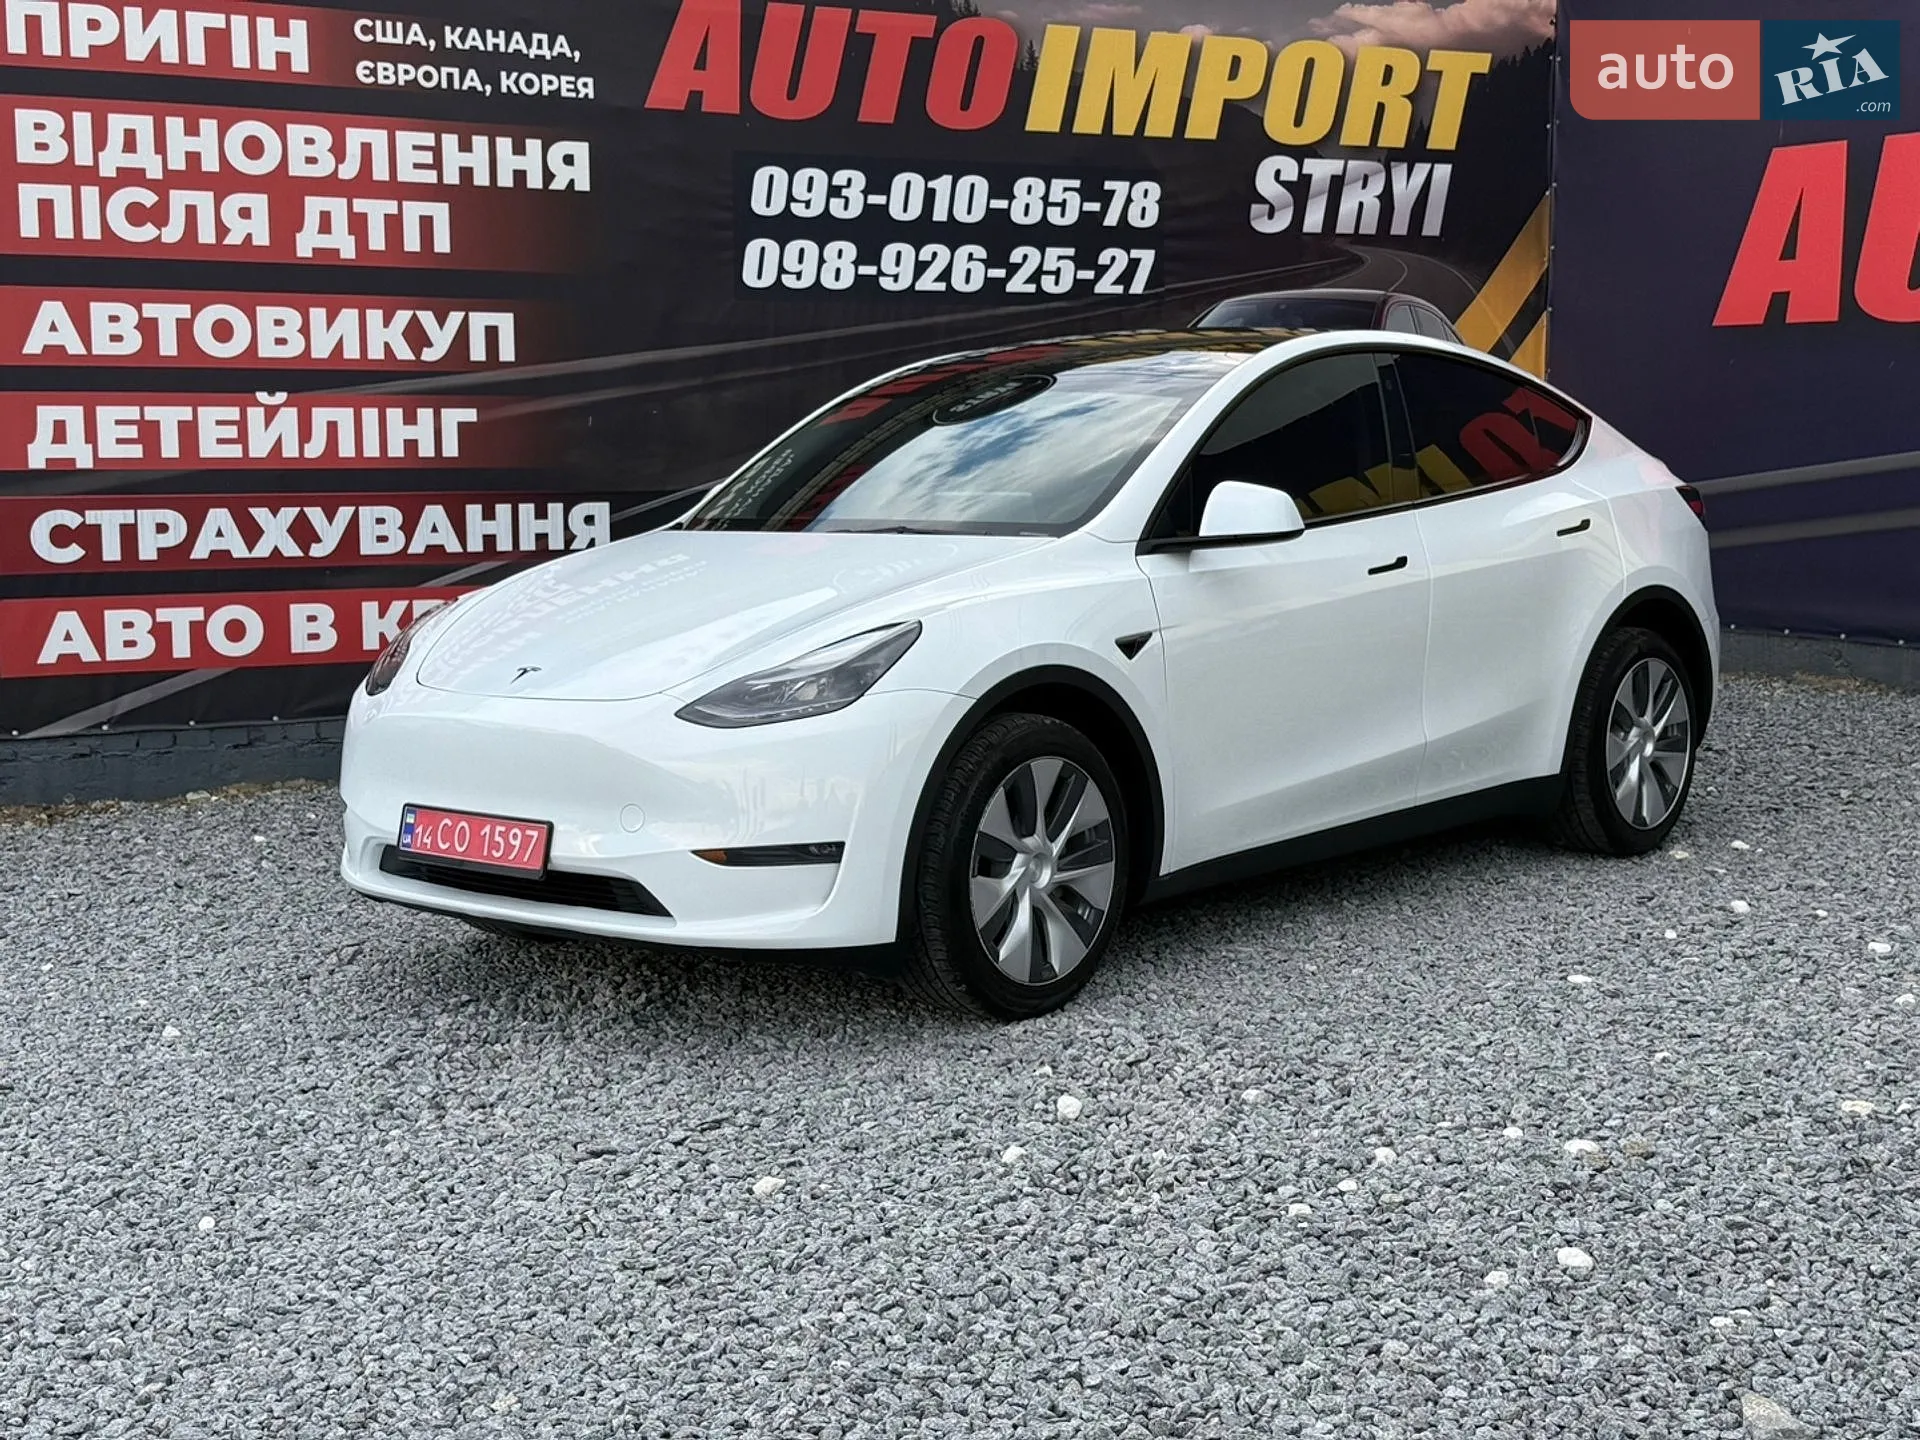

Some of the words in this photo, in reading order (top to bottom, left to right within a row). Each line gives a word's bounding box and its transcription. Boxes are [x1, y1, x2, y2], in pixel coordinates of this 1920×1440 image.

[5, 0, 310, 73] ПРИГІН
[353, 18, 436, 51] США,
[443, 25, 581, 62] КАНАДА,
[355, 60, 492, 96] ЄВРОПА,
[499, 70, 595, 99] КОРЕЯ
[644, 0, 1018, 130] AUTO
[1024, 24, 1492, 150] IMPORT
[14, 108, 591, 192] ВІДНОВЛЕННЯ
[18, 183, 271, 247] ПІСЛЯ
[296, 196, 452, 259] ДТП
[750, 165, 1161, 229] 093-010-85-78
[1249, 155, 1452, 237] STRYI
[742, 238, 1156, 295] 098-926-25-27
[22, 300, 516, 362] АВТОВИКУП
[27, 391, 478, 469] ДЕТЕЙЛІНГ
[29, 502, 610, 565] СТРАХУВАННЯ
[37, 604, 264, 664] АВТО
[290, 603, 338, 653] В
[480, 824, 539, 862] 1597
